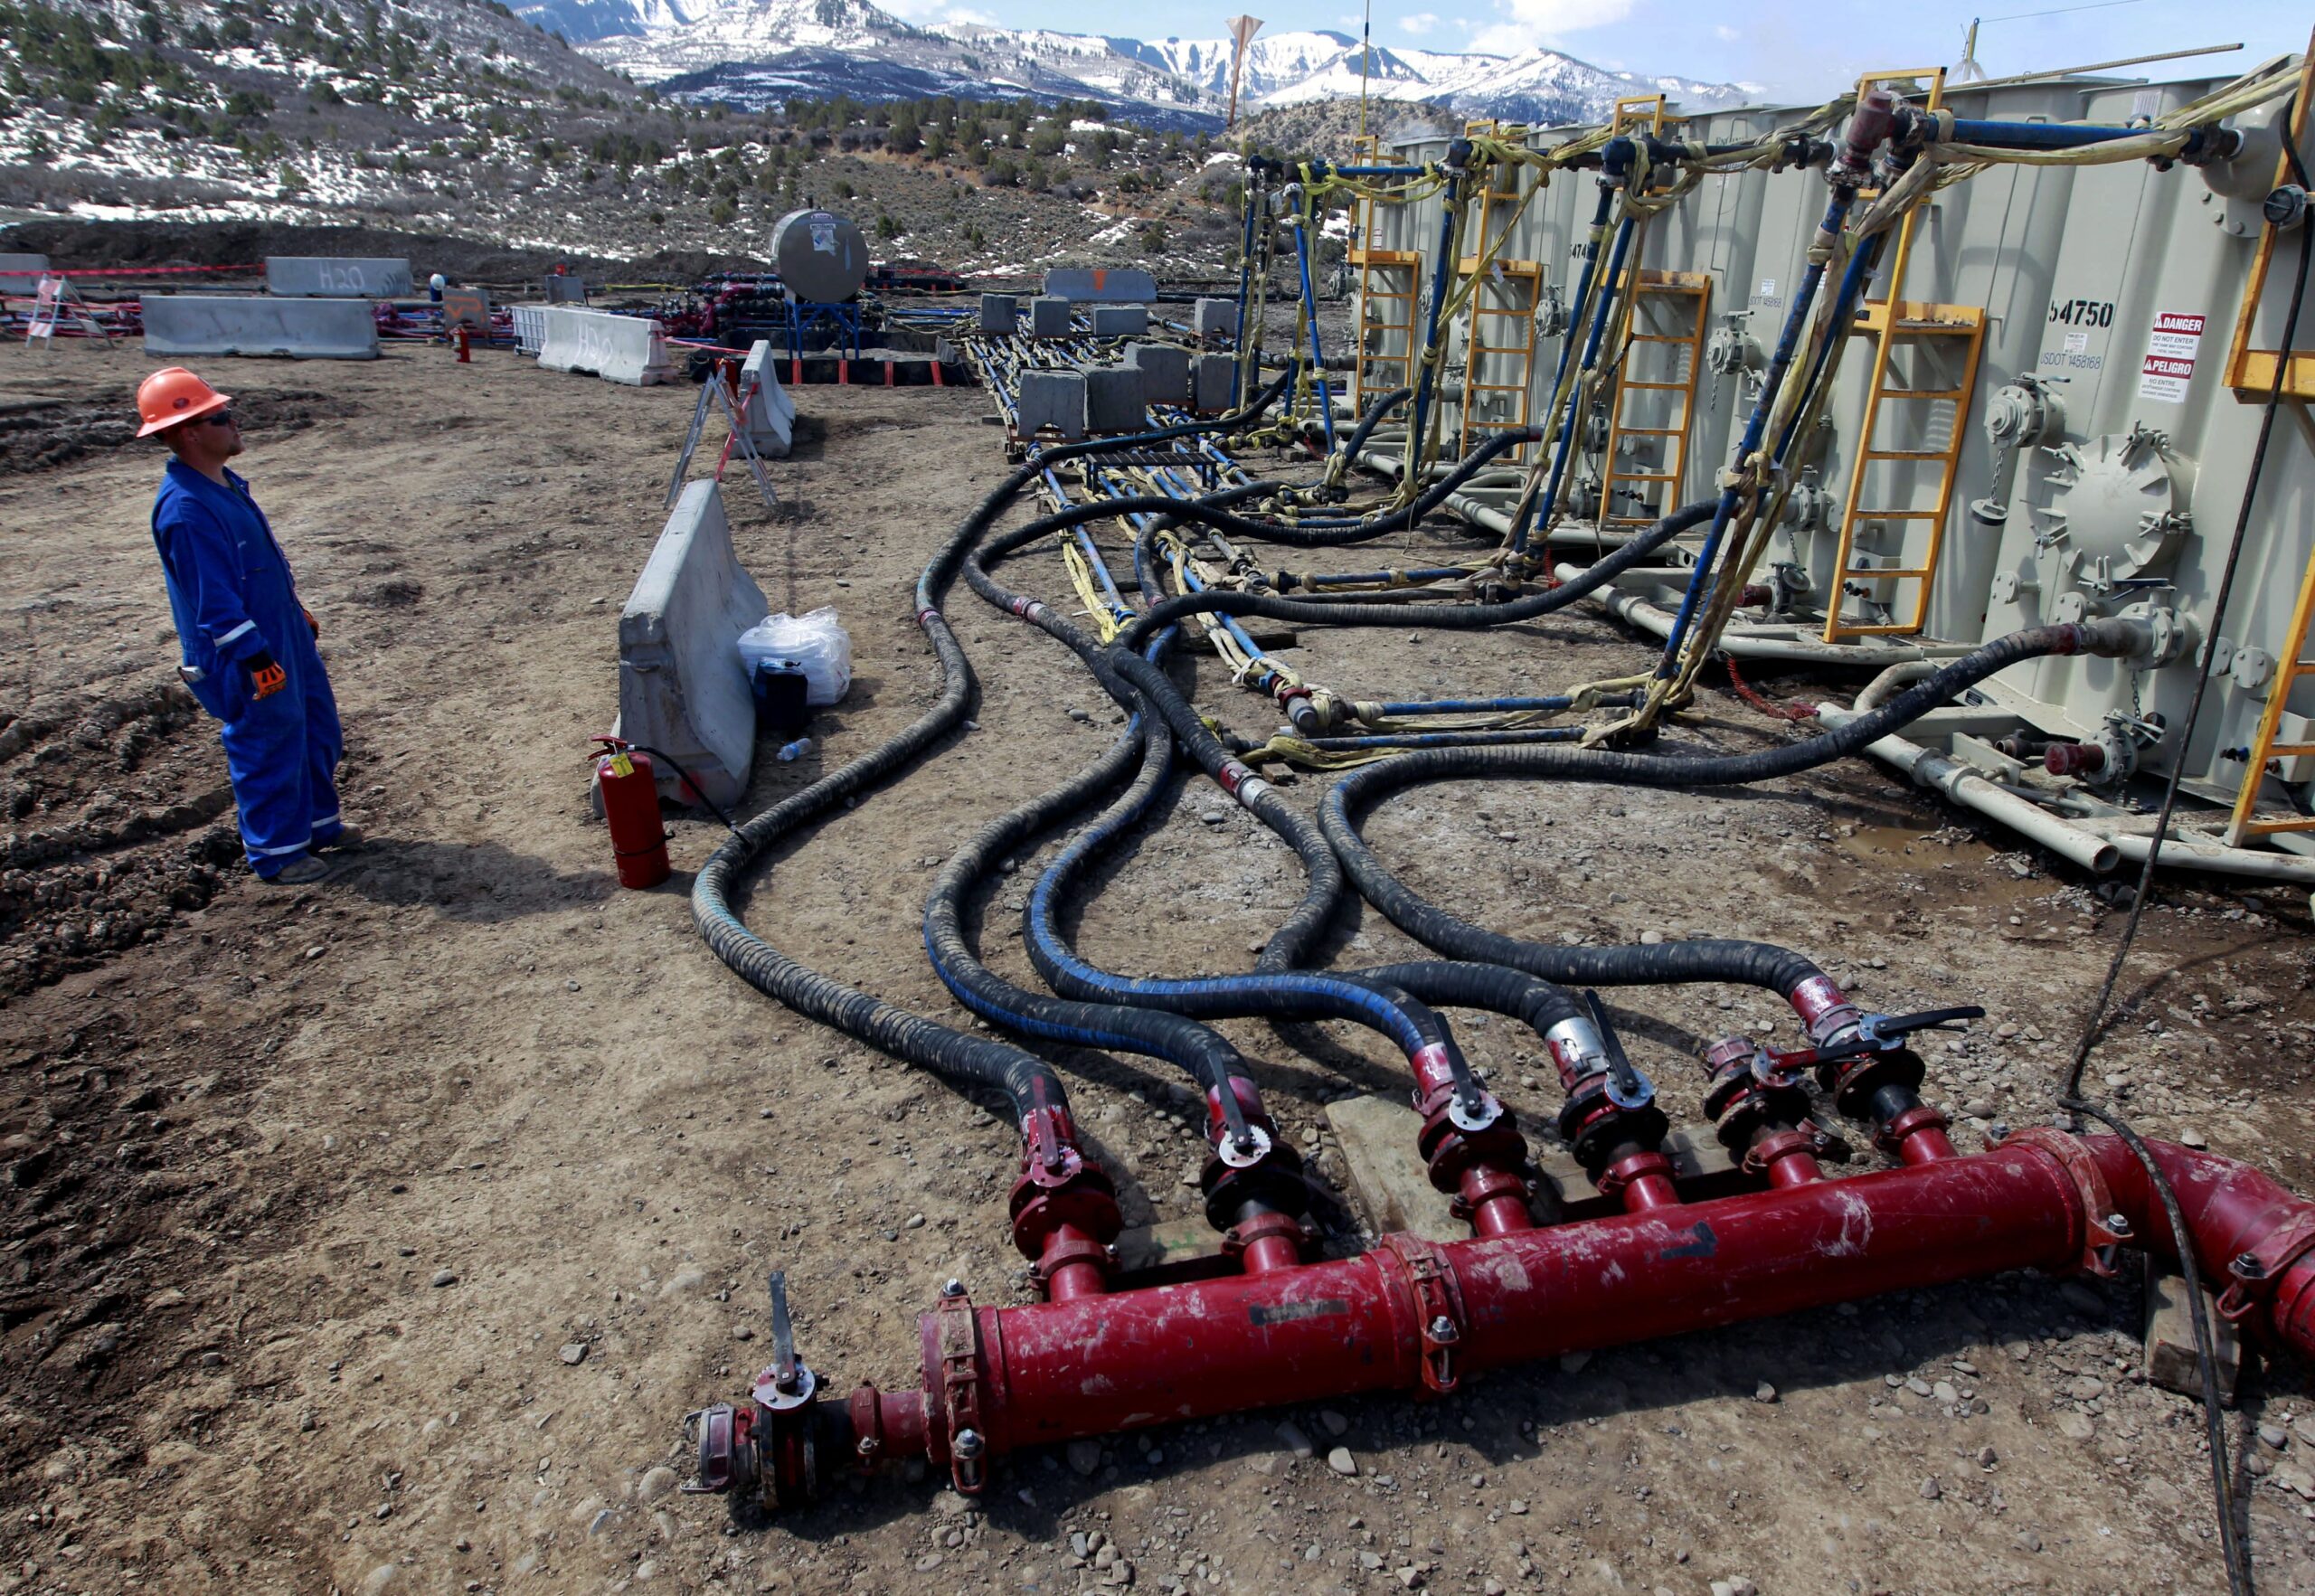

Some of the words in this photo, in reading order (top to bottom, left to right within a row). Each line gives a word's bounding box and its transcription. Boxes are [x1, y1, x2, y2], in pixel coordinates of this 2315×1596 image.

[1568, 243, 1590, 259] 5474
[319, 260, 365, 289] H2O
[2049, 299, 2113, 328] 54750
[2162, 316, 2203, 332] DANGER
[2068, 354, 2102, 370] 1458168
[2152, 360, 2192, 375] PELIGRO
